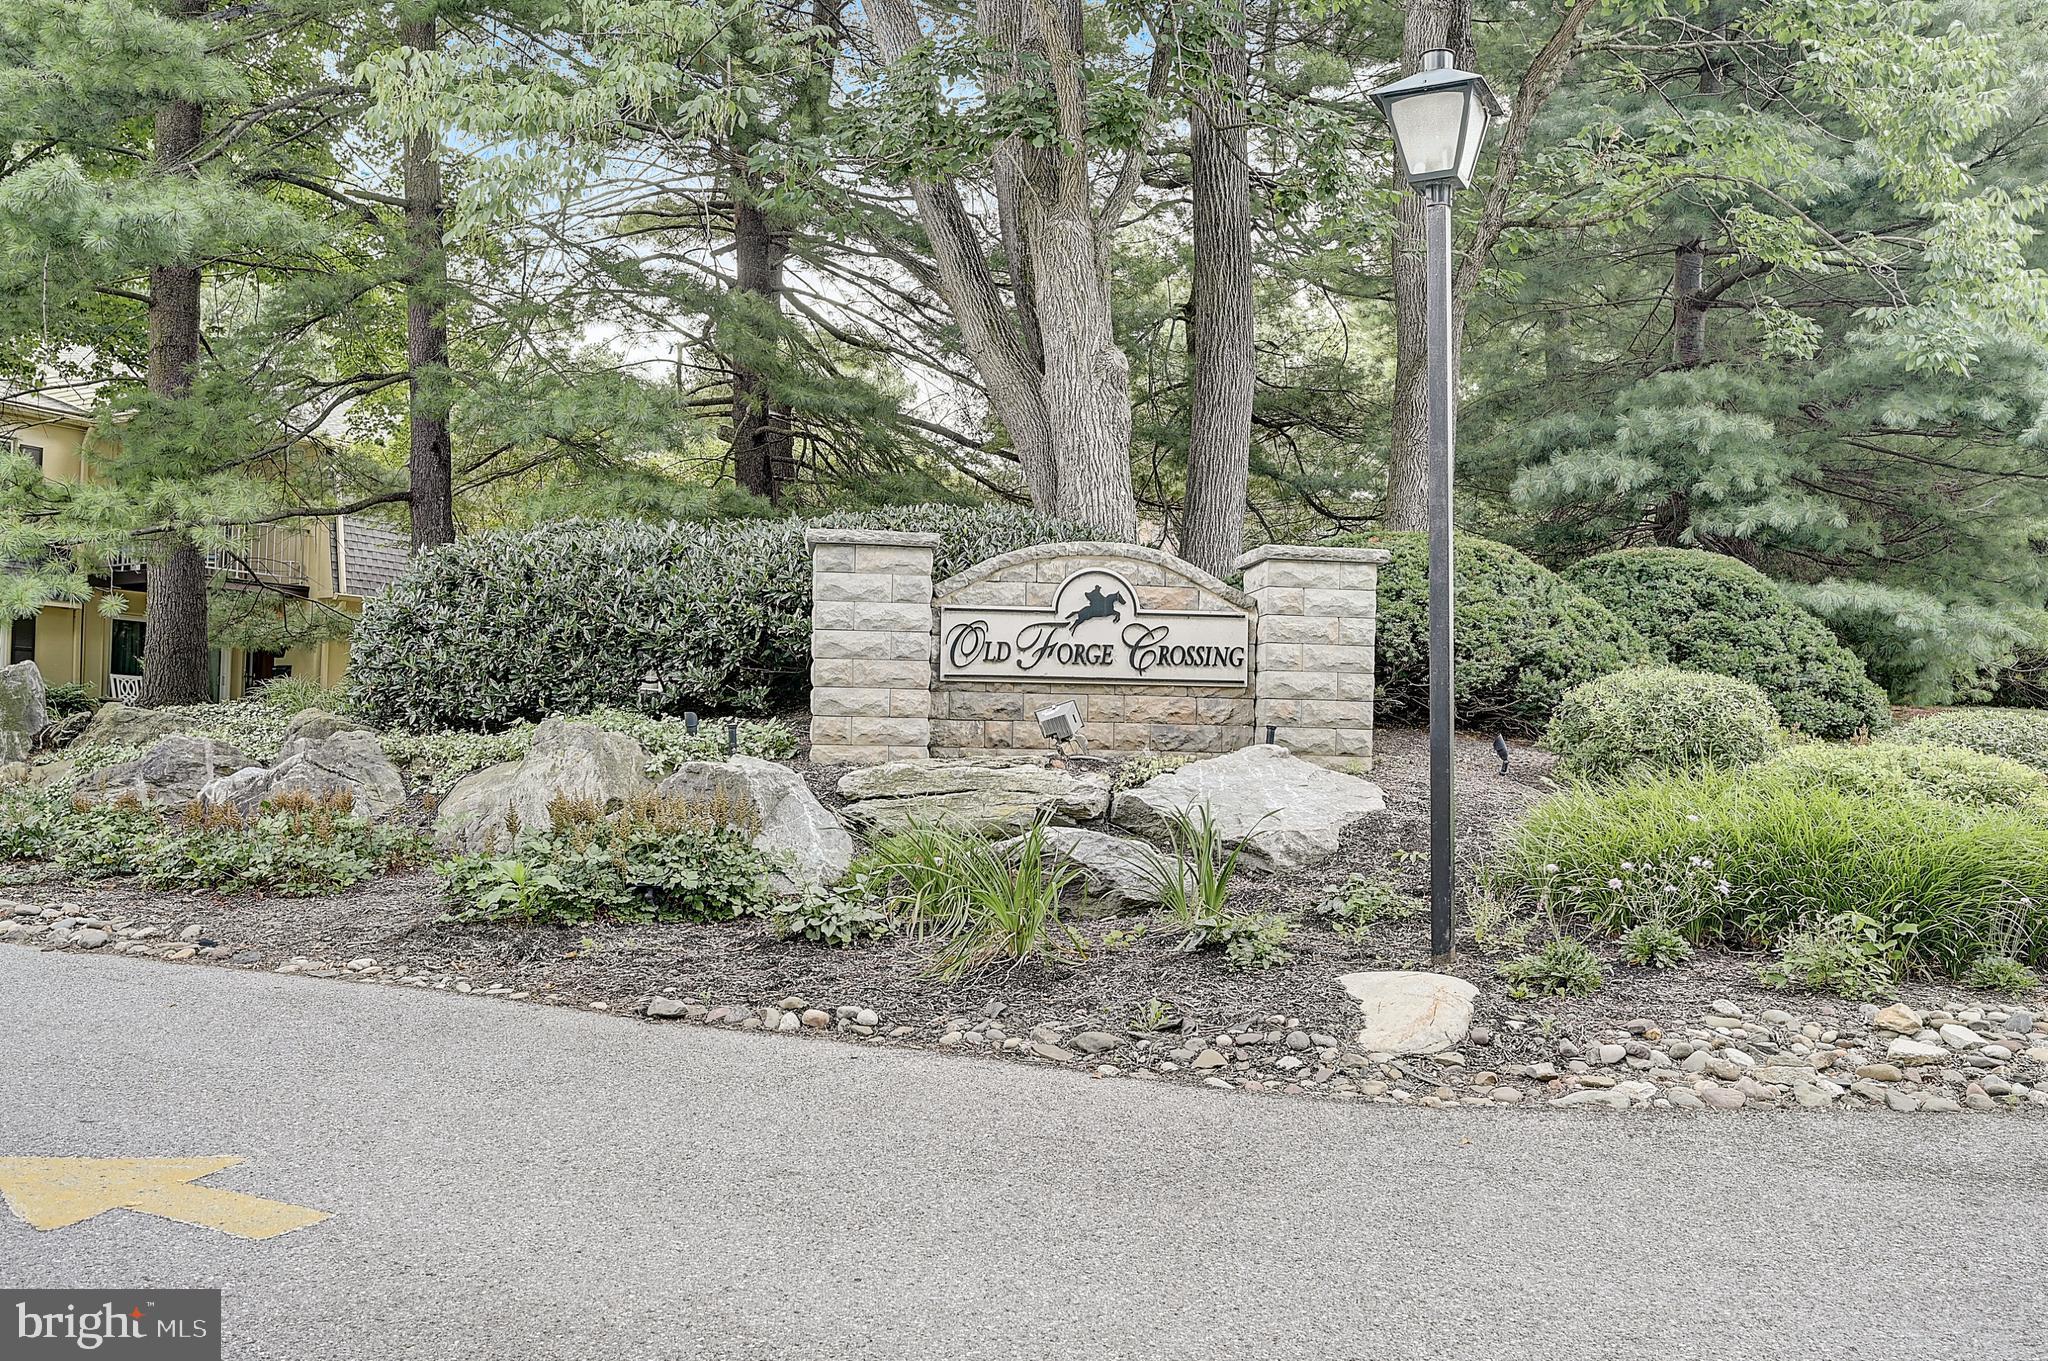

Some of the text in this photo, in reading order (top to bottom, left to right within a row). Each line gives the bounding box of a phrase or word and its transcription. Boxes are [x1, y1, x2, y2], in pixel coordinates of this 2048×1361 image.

[945, 620, 1245, 676] OLD FORGE CROSSING
